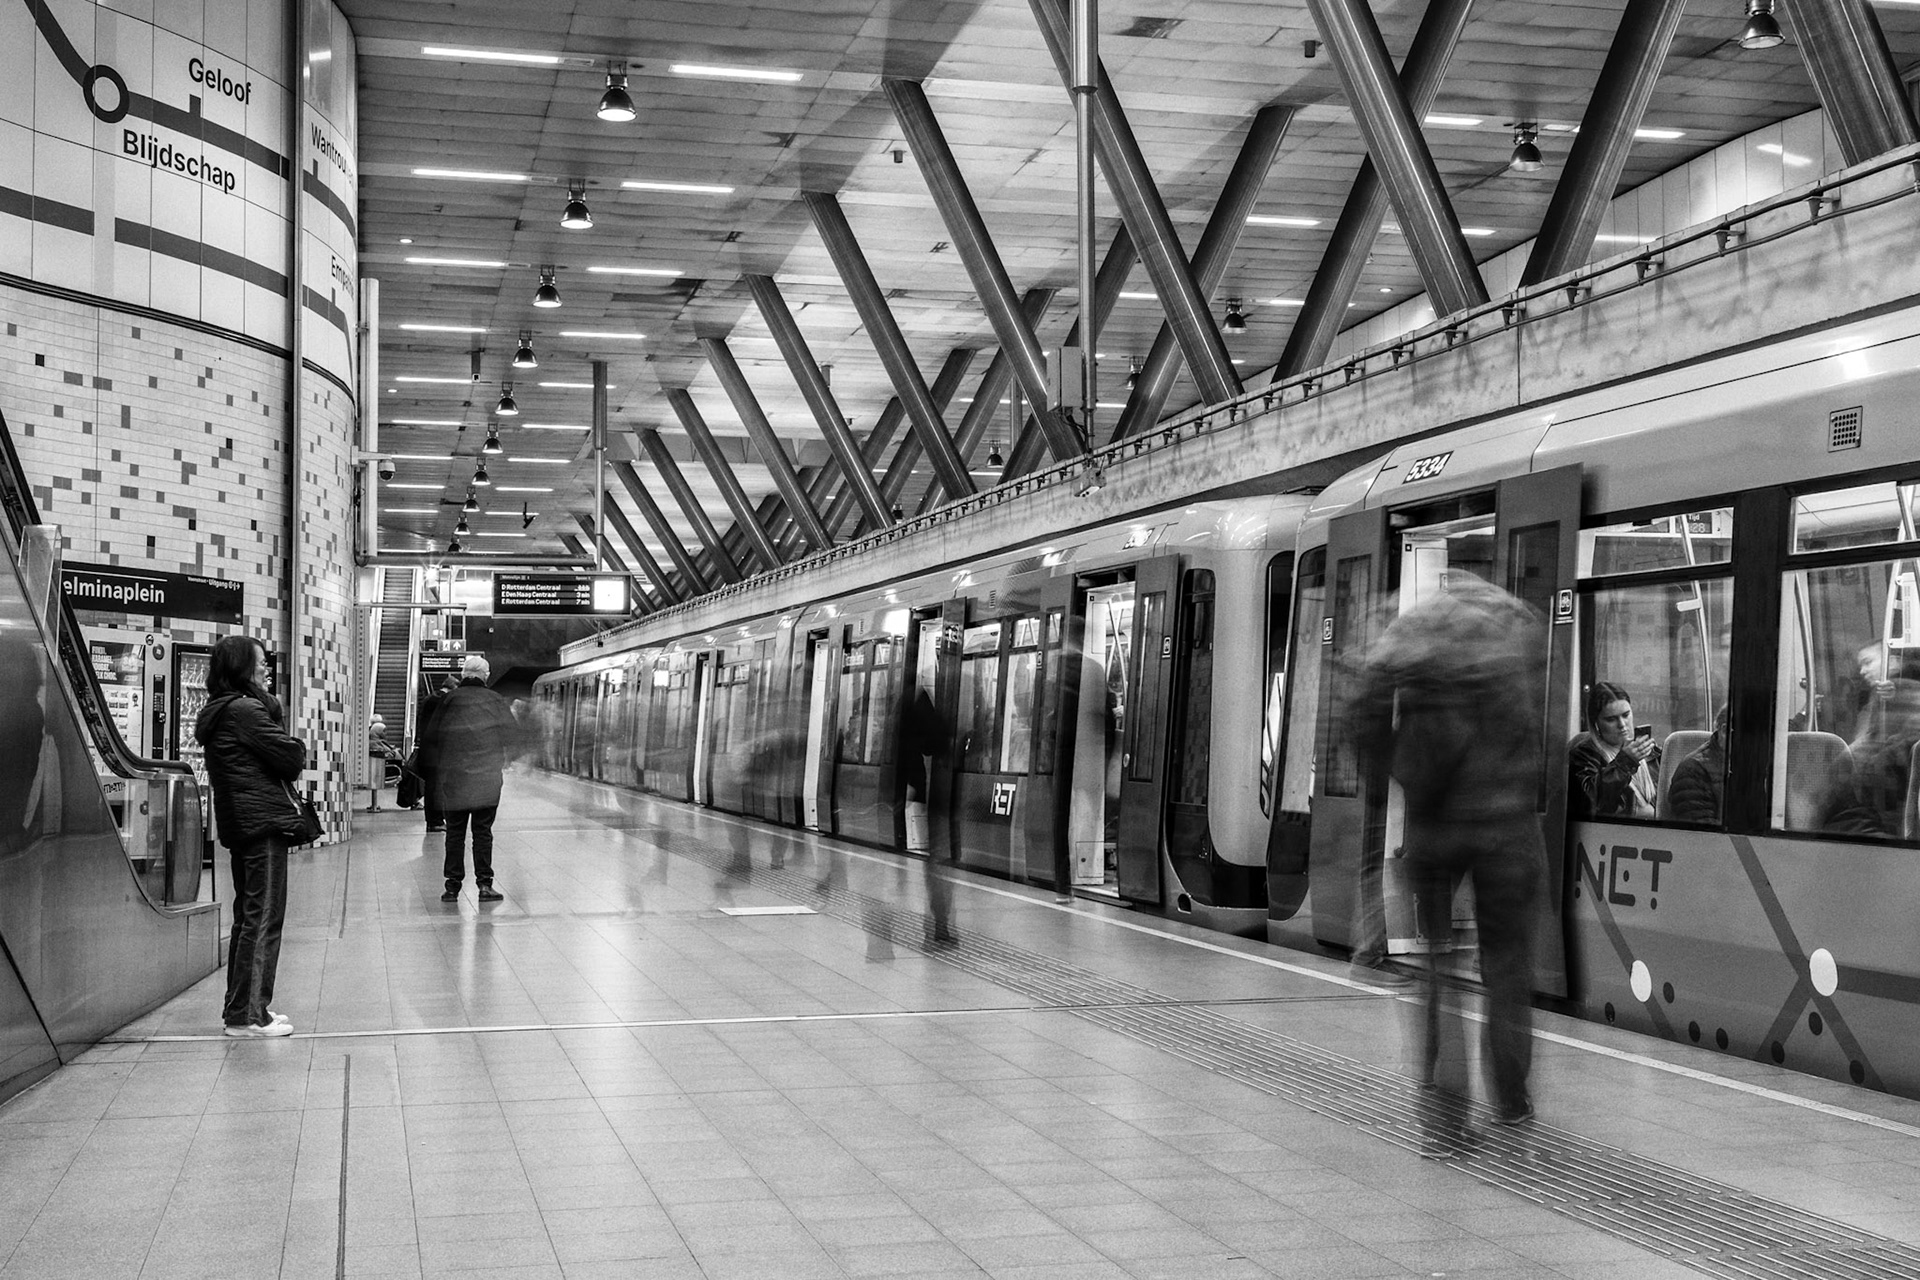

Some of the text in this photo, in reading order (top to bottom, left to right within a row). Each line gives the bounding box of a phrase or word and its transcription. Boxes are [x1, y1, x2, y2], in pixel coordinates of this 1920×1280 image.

[188, 57, 252, 105] Geloof
[123, 128, 236, 194] Blijdschap
[311, 122, 352, 186] Wantrouen
[1405, 454, 1450, 482] 5334
[1688, 513, 1700, 522] Tijd
[208, 578, 228, 589] Uitgang
[989, 782, 1017, 816] RET
